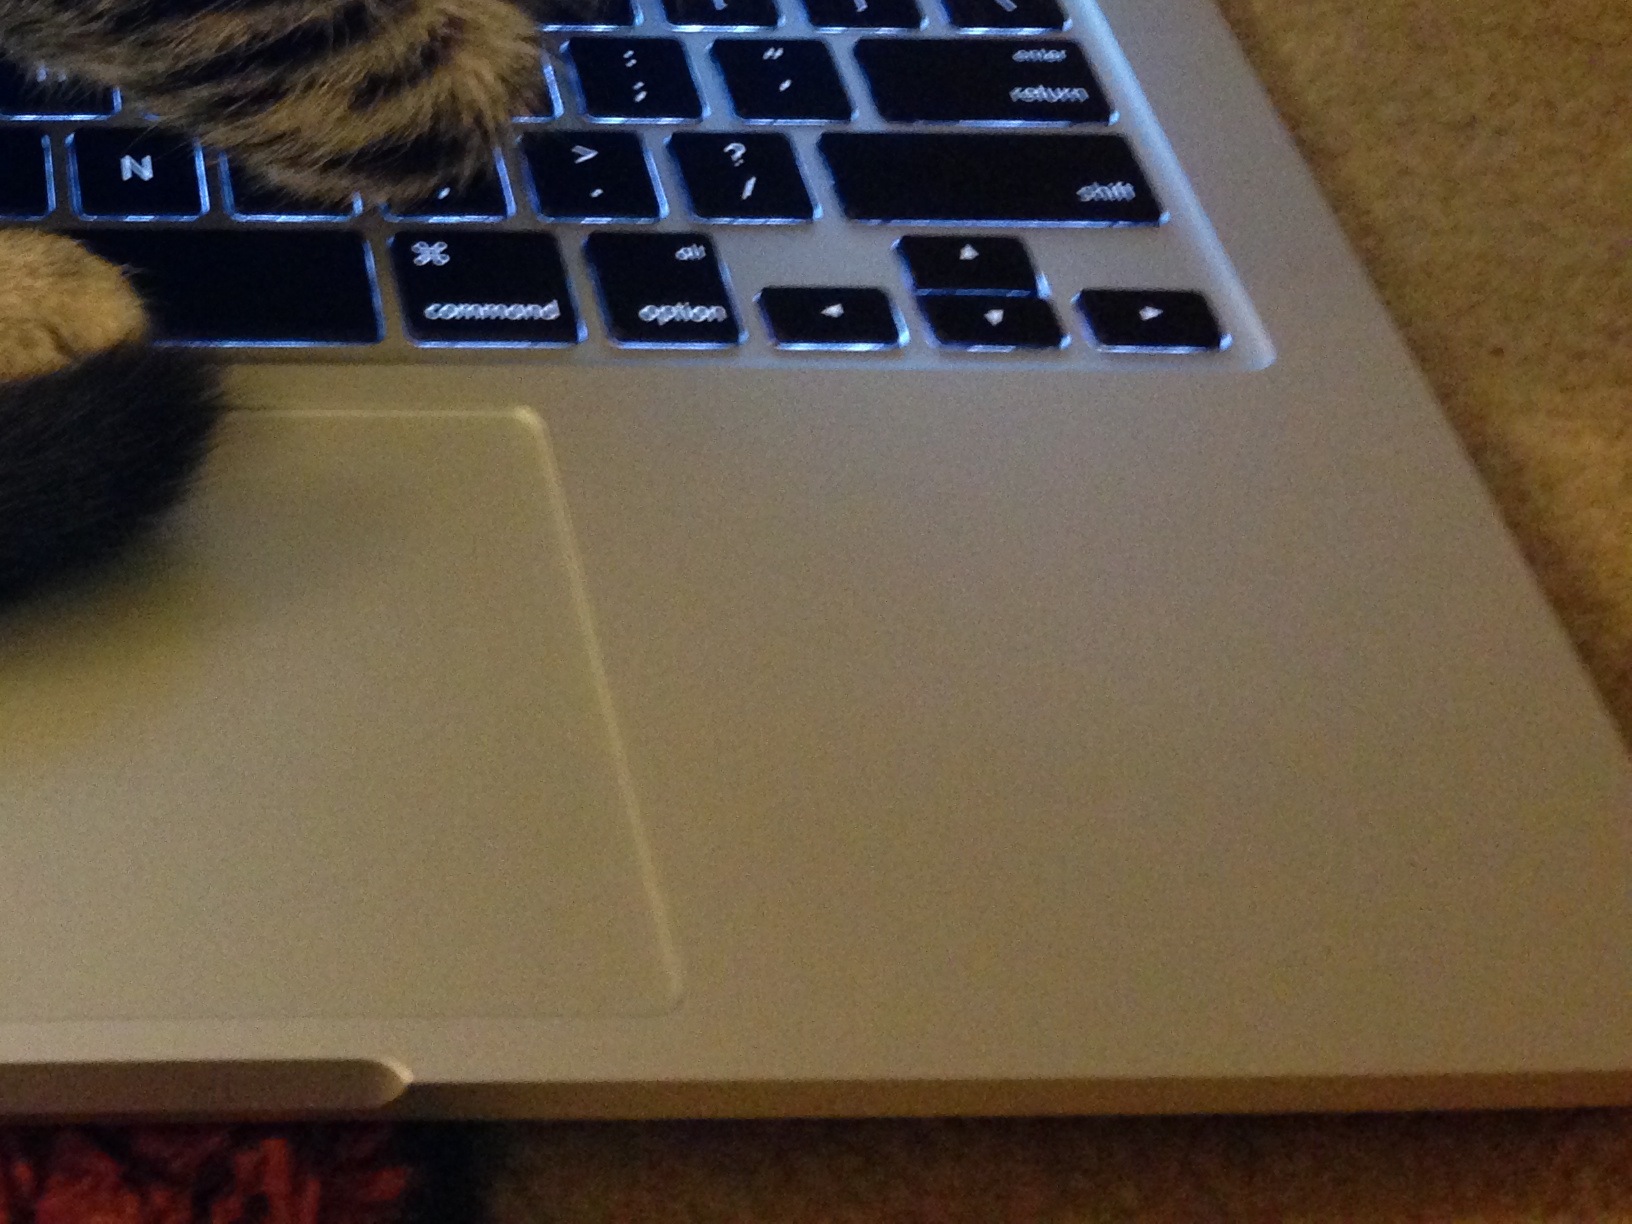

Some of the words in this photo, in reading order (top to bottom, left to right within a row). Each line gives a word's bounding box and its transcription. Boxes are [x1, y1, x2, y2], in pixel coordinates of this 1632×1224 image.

[1012, 49, 1066, 62] enter
[1010, 85, 1089, 103] return
[724, 143, 746, 166] ?
[121, 155, 153, 181] N
[1077, 181, 1135, 201] shift
[675, 244, 706, 260] alt
[424, 300, 560, 320] command
[639, 302, 728, 325] option
